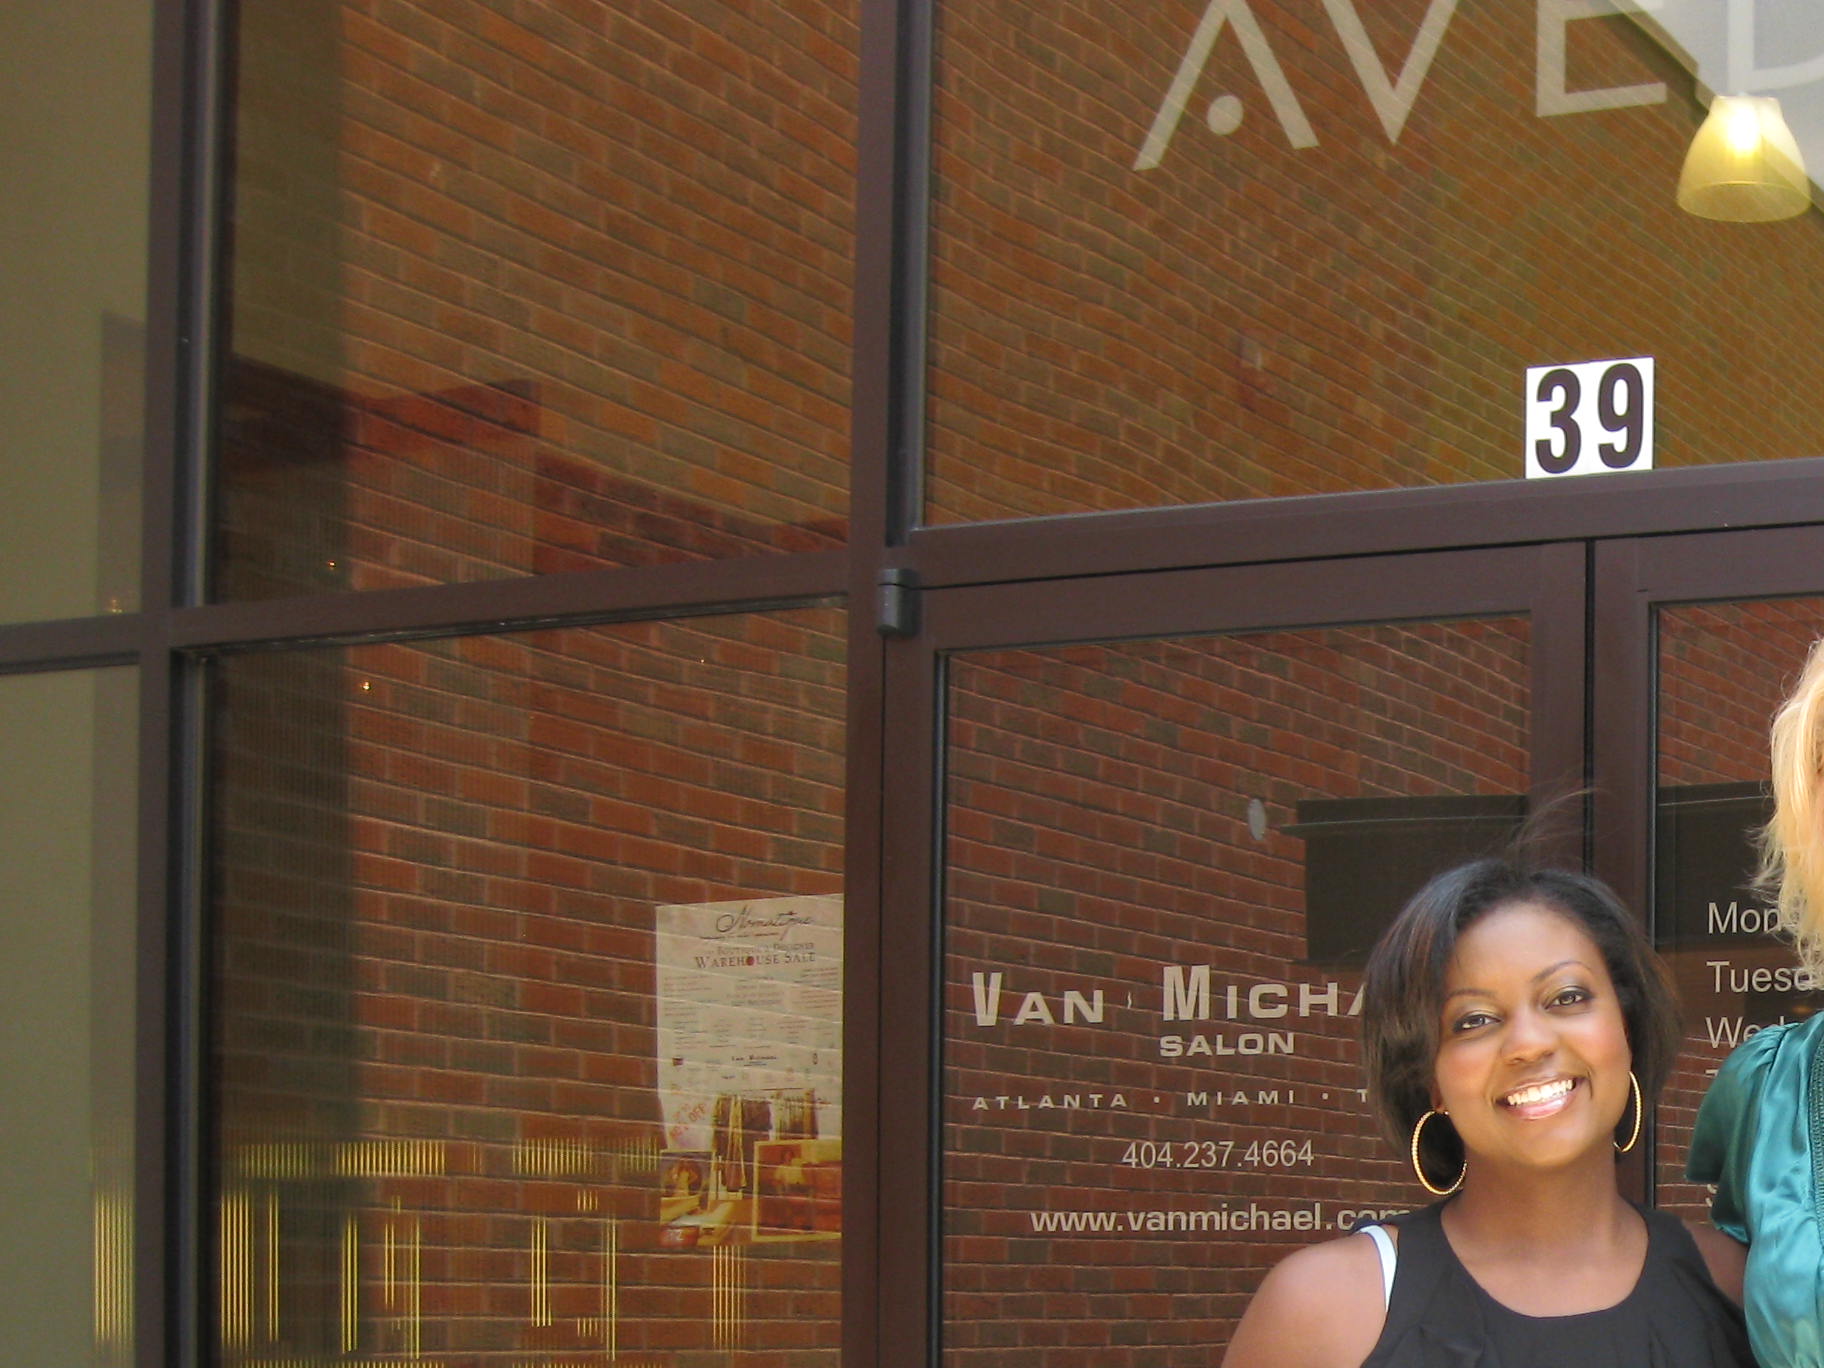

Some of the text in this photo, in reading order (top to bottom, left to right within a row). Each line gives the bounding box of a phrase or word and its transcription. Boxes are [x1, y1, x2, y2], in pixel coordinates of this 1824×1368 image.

[1535, 363, 1644, 474] 39
[1708, 902, 1781, 934] Mon
[1163, 965, 1366, 1022] MICH
[1160, 1032, 1295, 1057] SALON
[972, 1089, 1295, 1111] ATLANTA MIAMI
[1122, 1140, 1315, 1169] 404.237.4664
